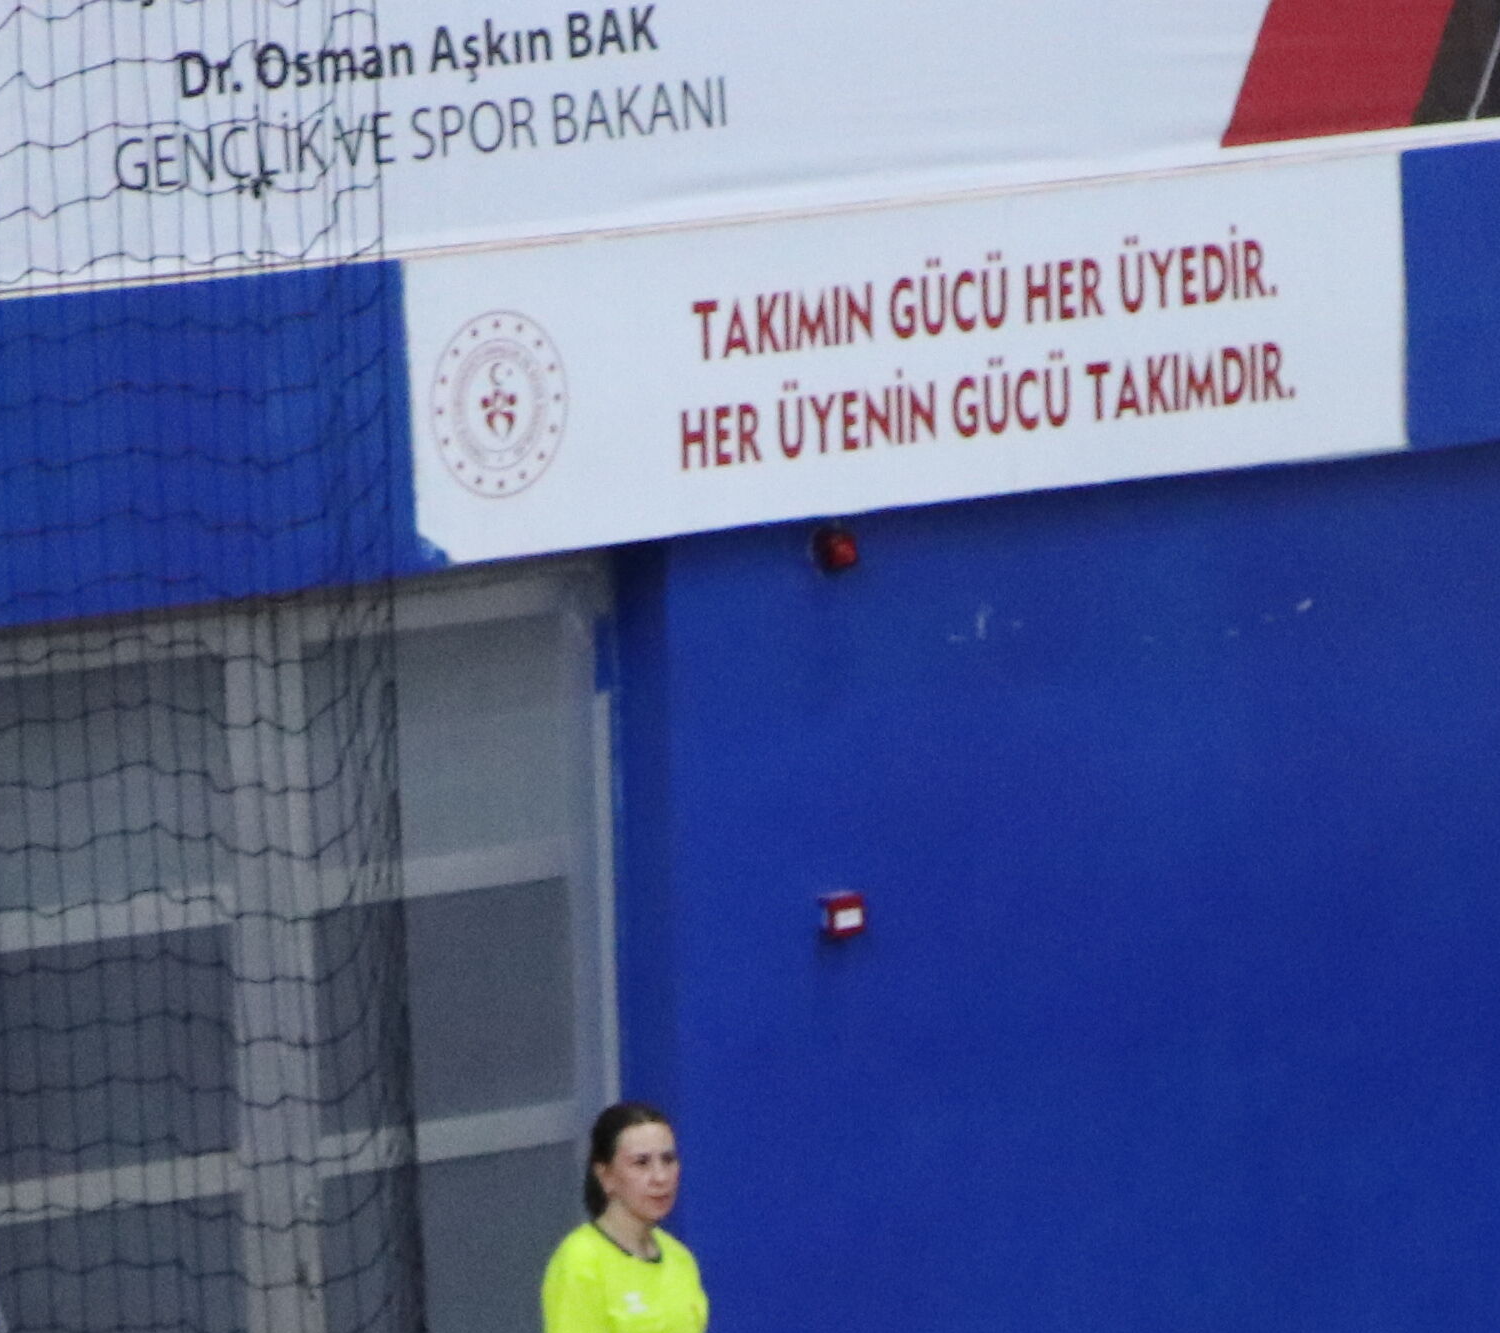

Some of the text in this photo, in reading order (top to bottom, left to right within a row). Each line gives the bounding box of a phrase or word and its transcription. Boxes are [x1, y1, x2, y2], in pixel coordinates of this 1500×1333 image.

[178, 4, 659, 98] Dr. Osman Aşkın BAK
[114, 76, 729, 193] GENÇLİK VE SPOR BAKANI
[693, 225, 1279, 362] TAKIMIN GÜCÜ HER ÜYEDİR.
[681, 341, 1297, 472] HER ÜYENİN GÜCÜ TAKIMDIR.
